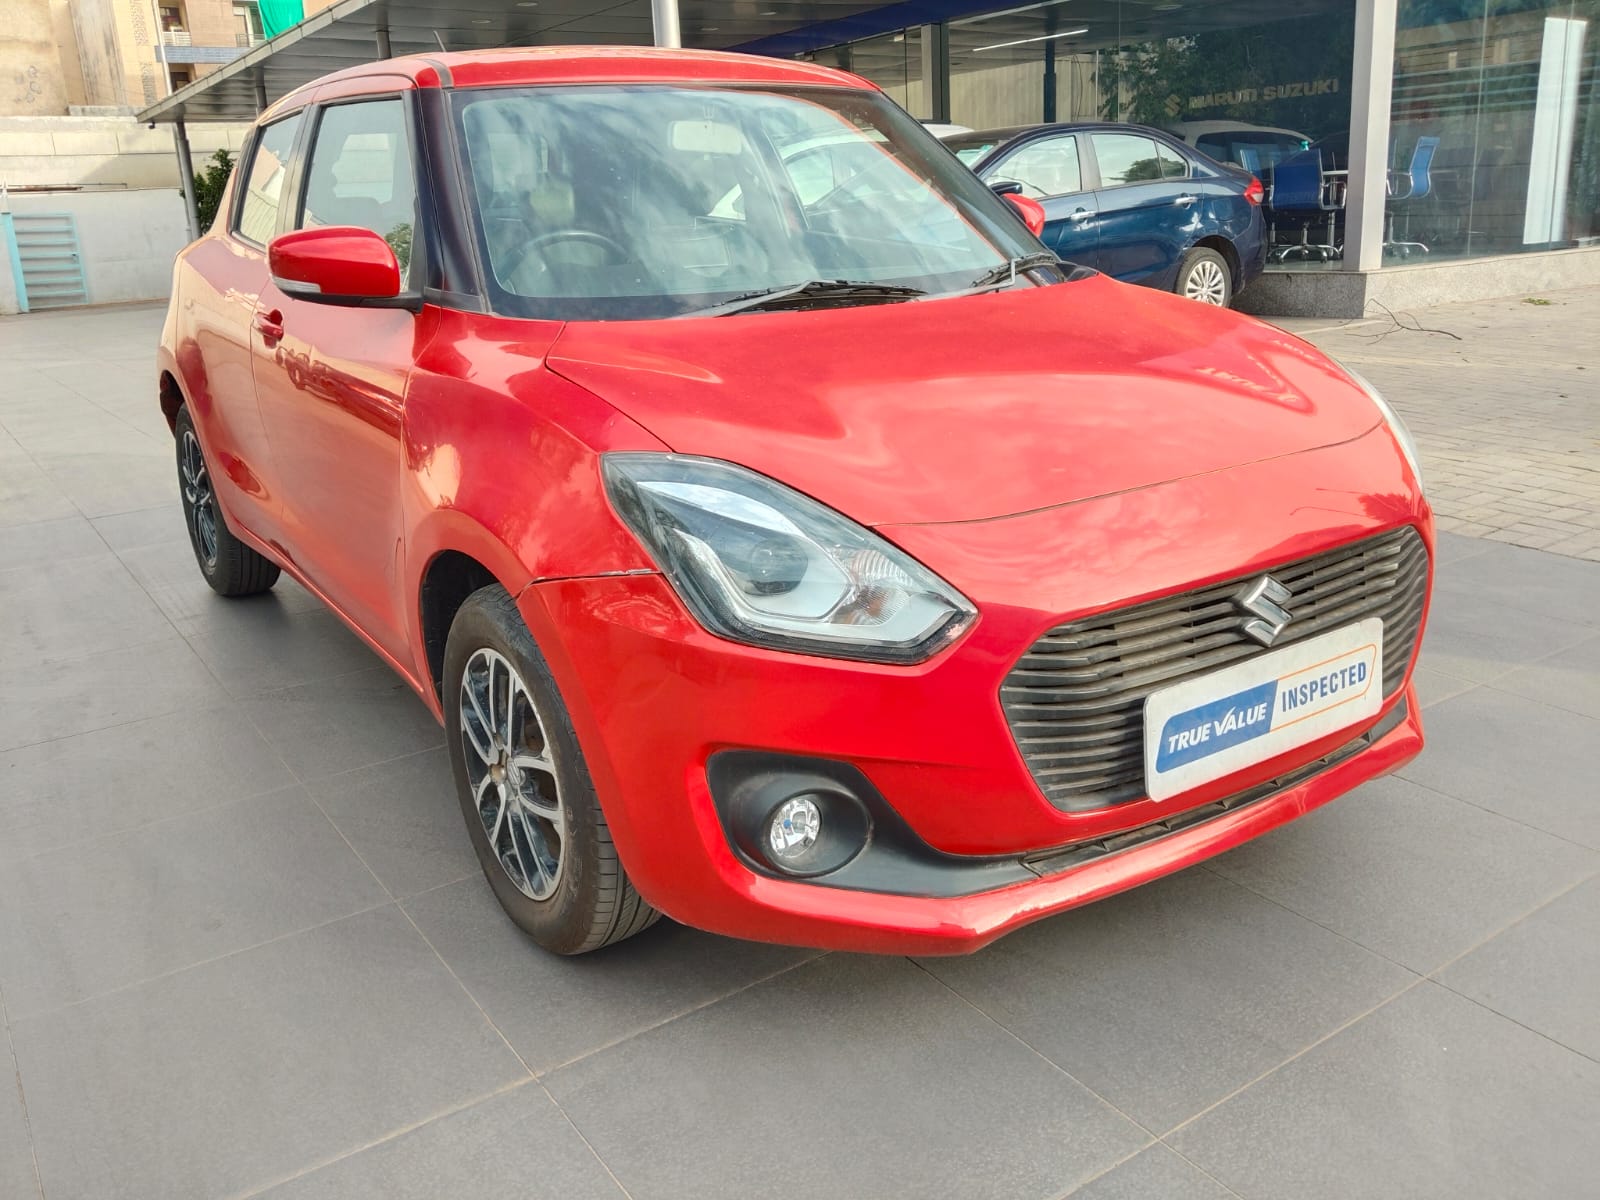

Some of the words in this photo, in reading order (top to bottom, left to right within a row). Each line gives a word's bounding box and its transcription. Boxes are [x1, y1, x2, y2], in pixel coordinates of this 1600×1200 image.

[1189, 88, 1258, 109] MARUTI
[1263, 78, 1339, 100] SUZUKI
[1168, 722, 1212, 754] TRUE
[1214, 702, 1267, 737] VALUE
[1282, 661, 1367, 712] INSPECTED
